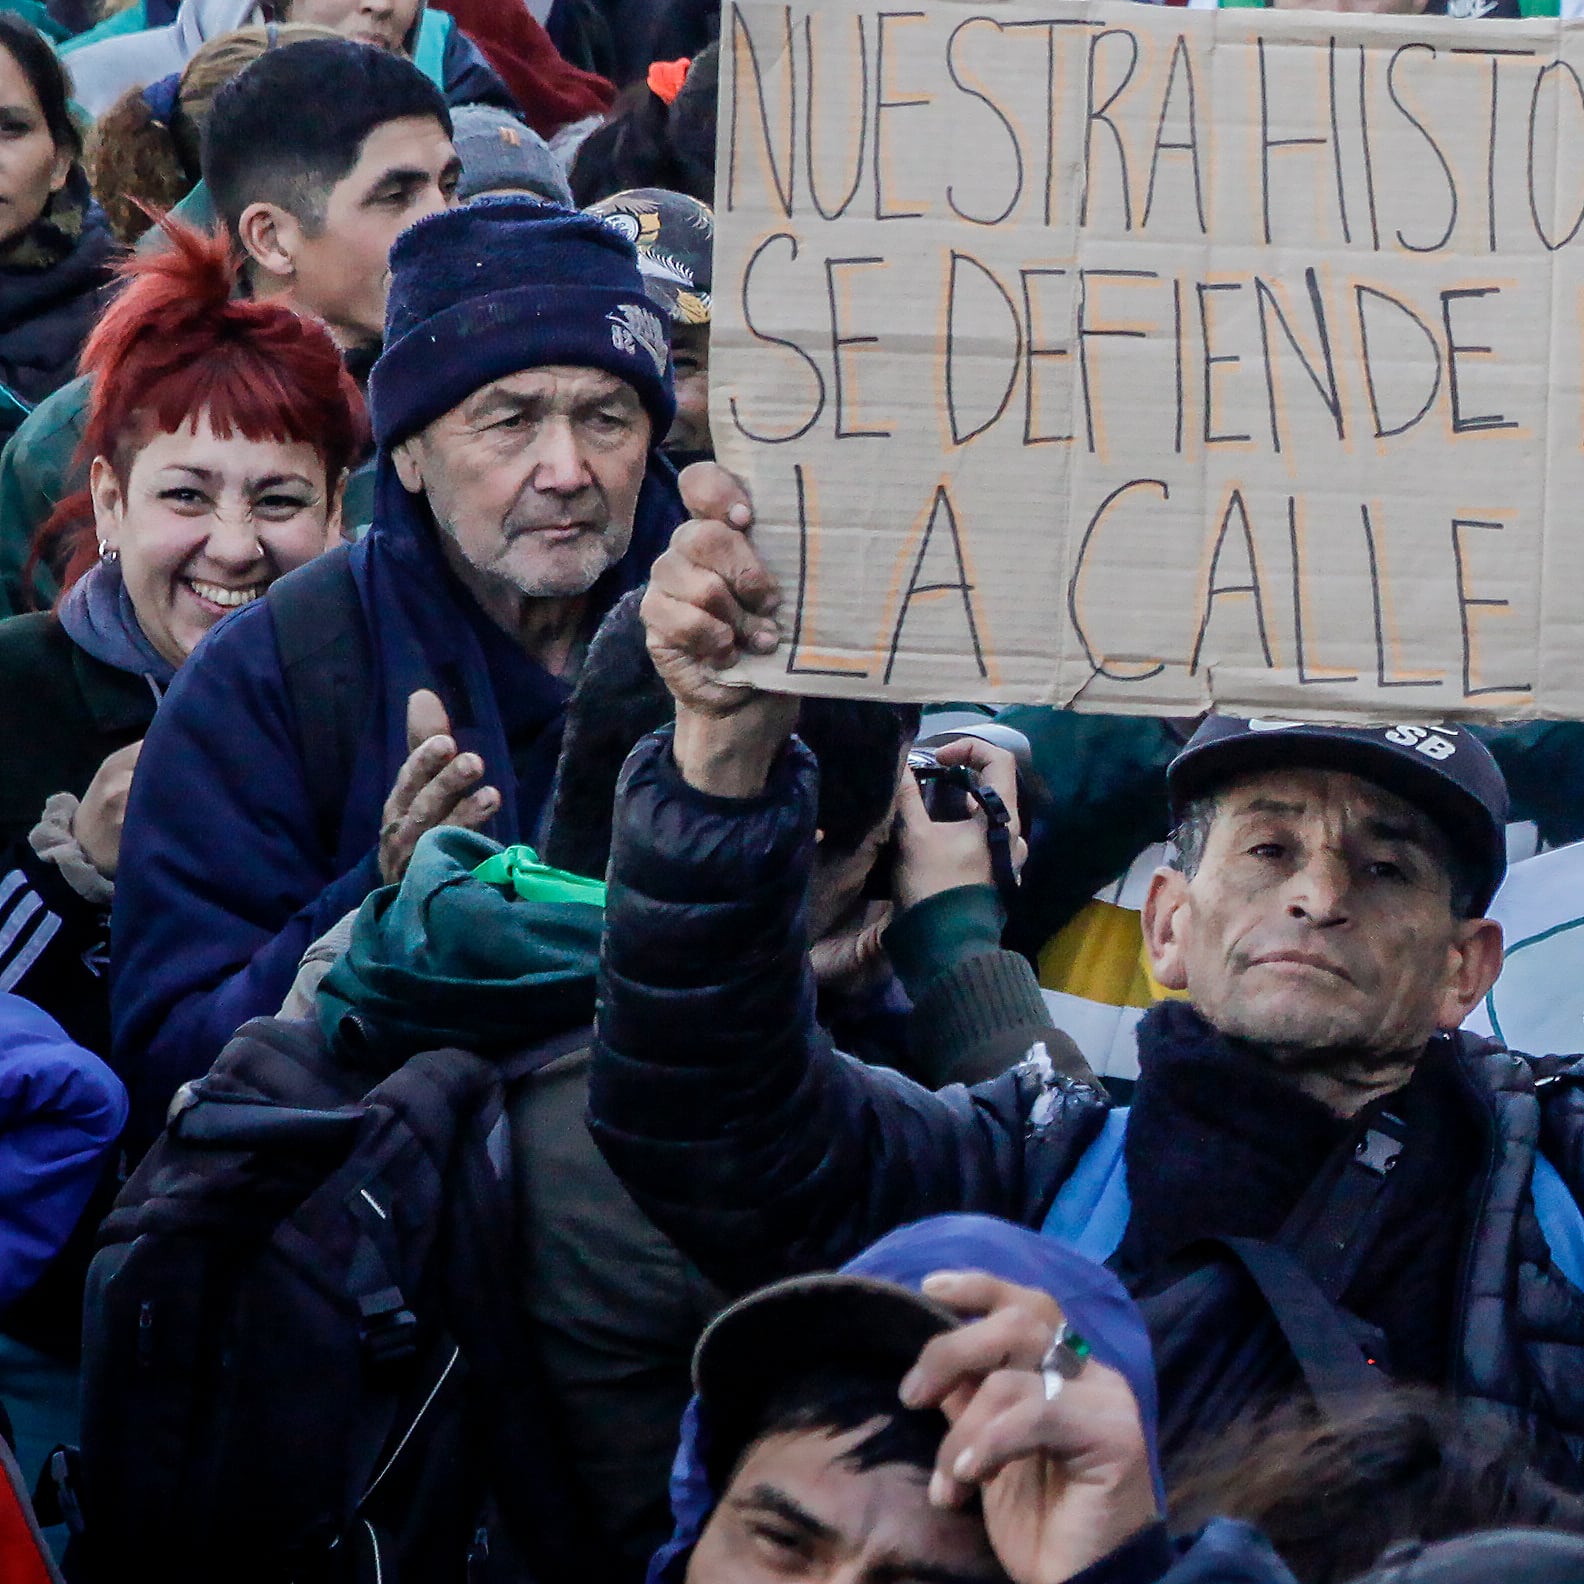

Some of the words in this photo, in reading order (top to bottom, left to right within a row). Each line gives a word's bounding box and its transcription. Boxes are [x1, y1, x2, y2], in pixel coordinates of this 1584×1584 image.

[727, 0, 1206, 234] NUESTRA
[728, 232, 892, 445] SE
[945, 248, 1520, 454] DEFIENDE
[786, 465, 990, 686] LA
[1066, 476, 1534, 700] CALLE
[1384, 724, 1456, 760] SB
